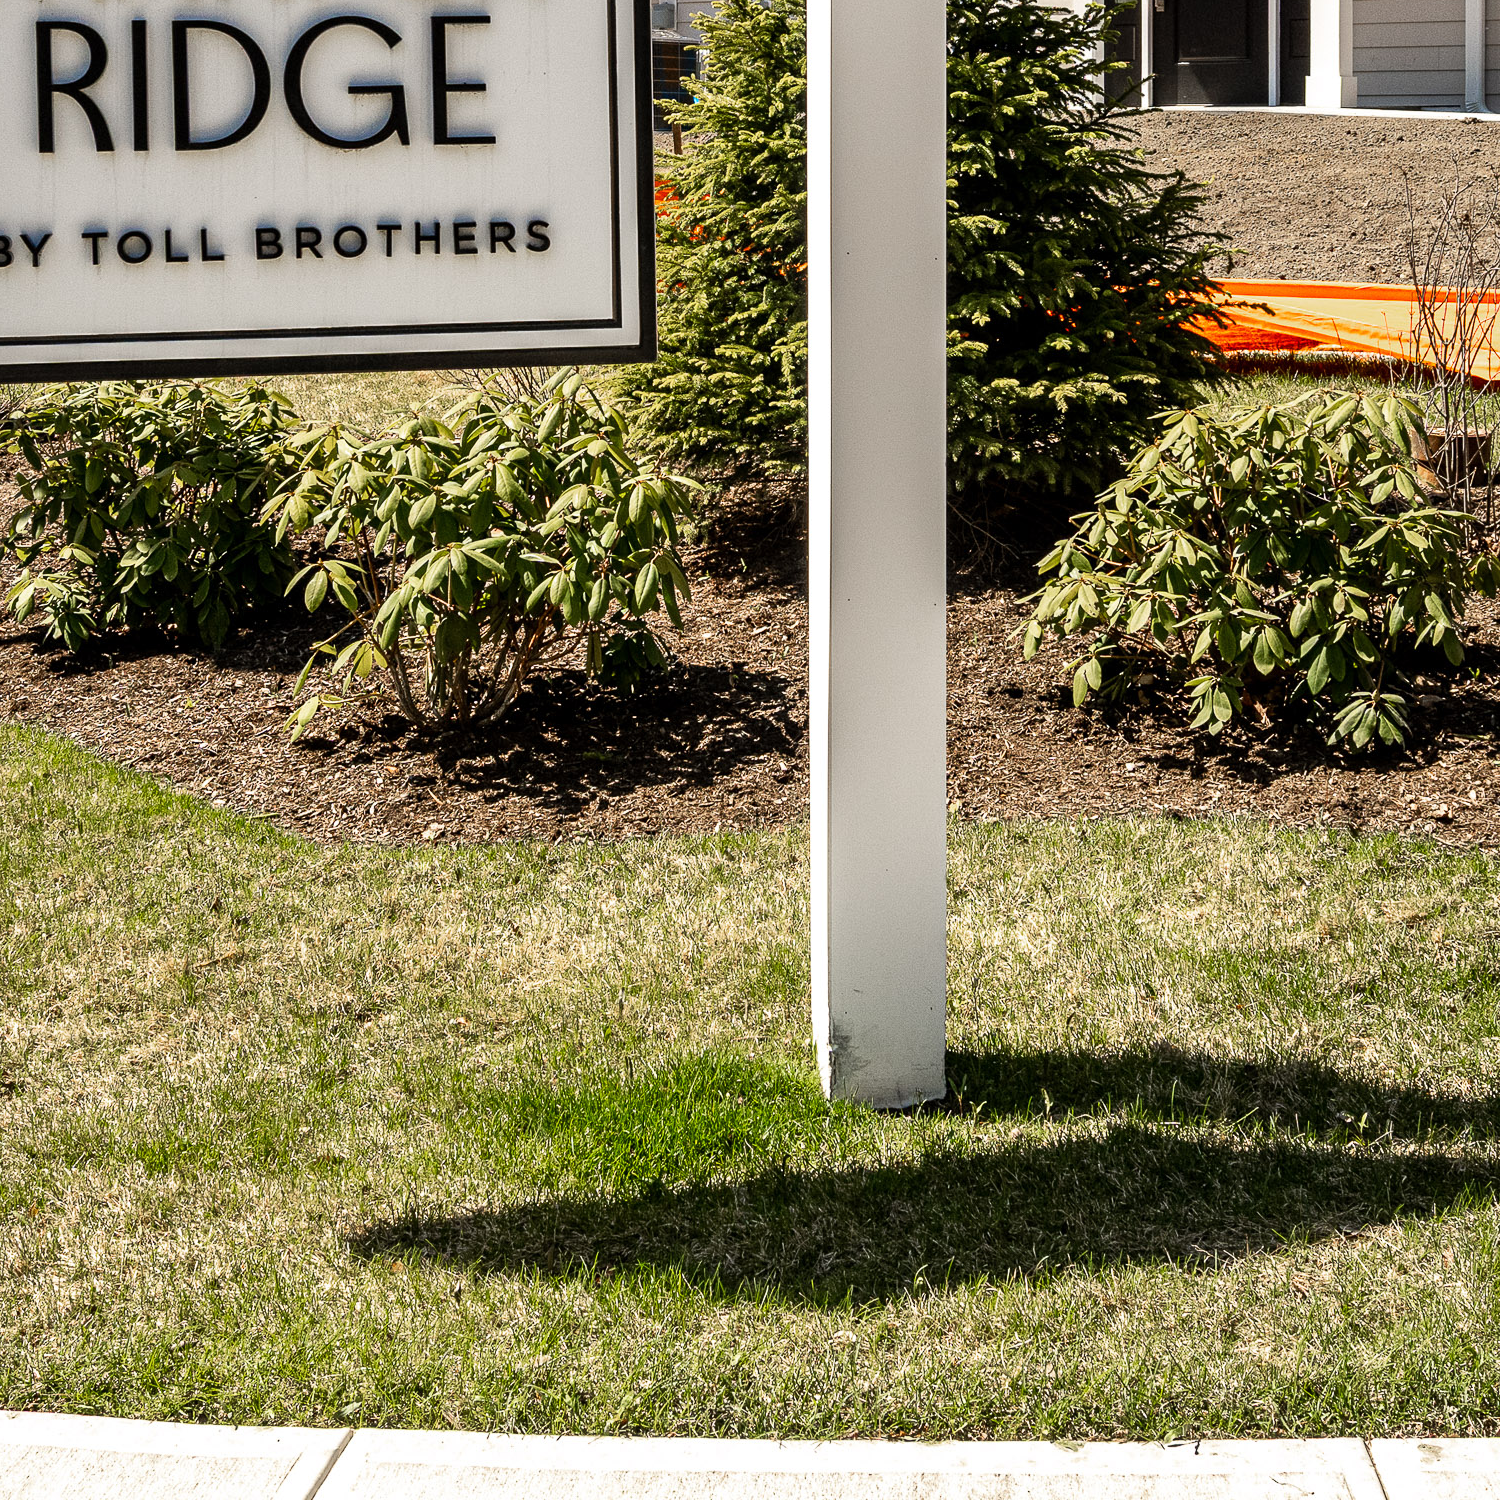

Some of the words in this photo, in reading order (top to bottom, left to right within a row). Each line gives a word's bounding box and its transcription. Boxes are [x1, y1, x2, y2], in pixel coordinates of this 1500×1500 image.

[36, 15, 496, 153] RIDGE
[82, 228, 225, 265] TOLL
[256, 220, 550, 259] BROTHERS
